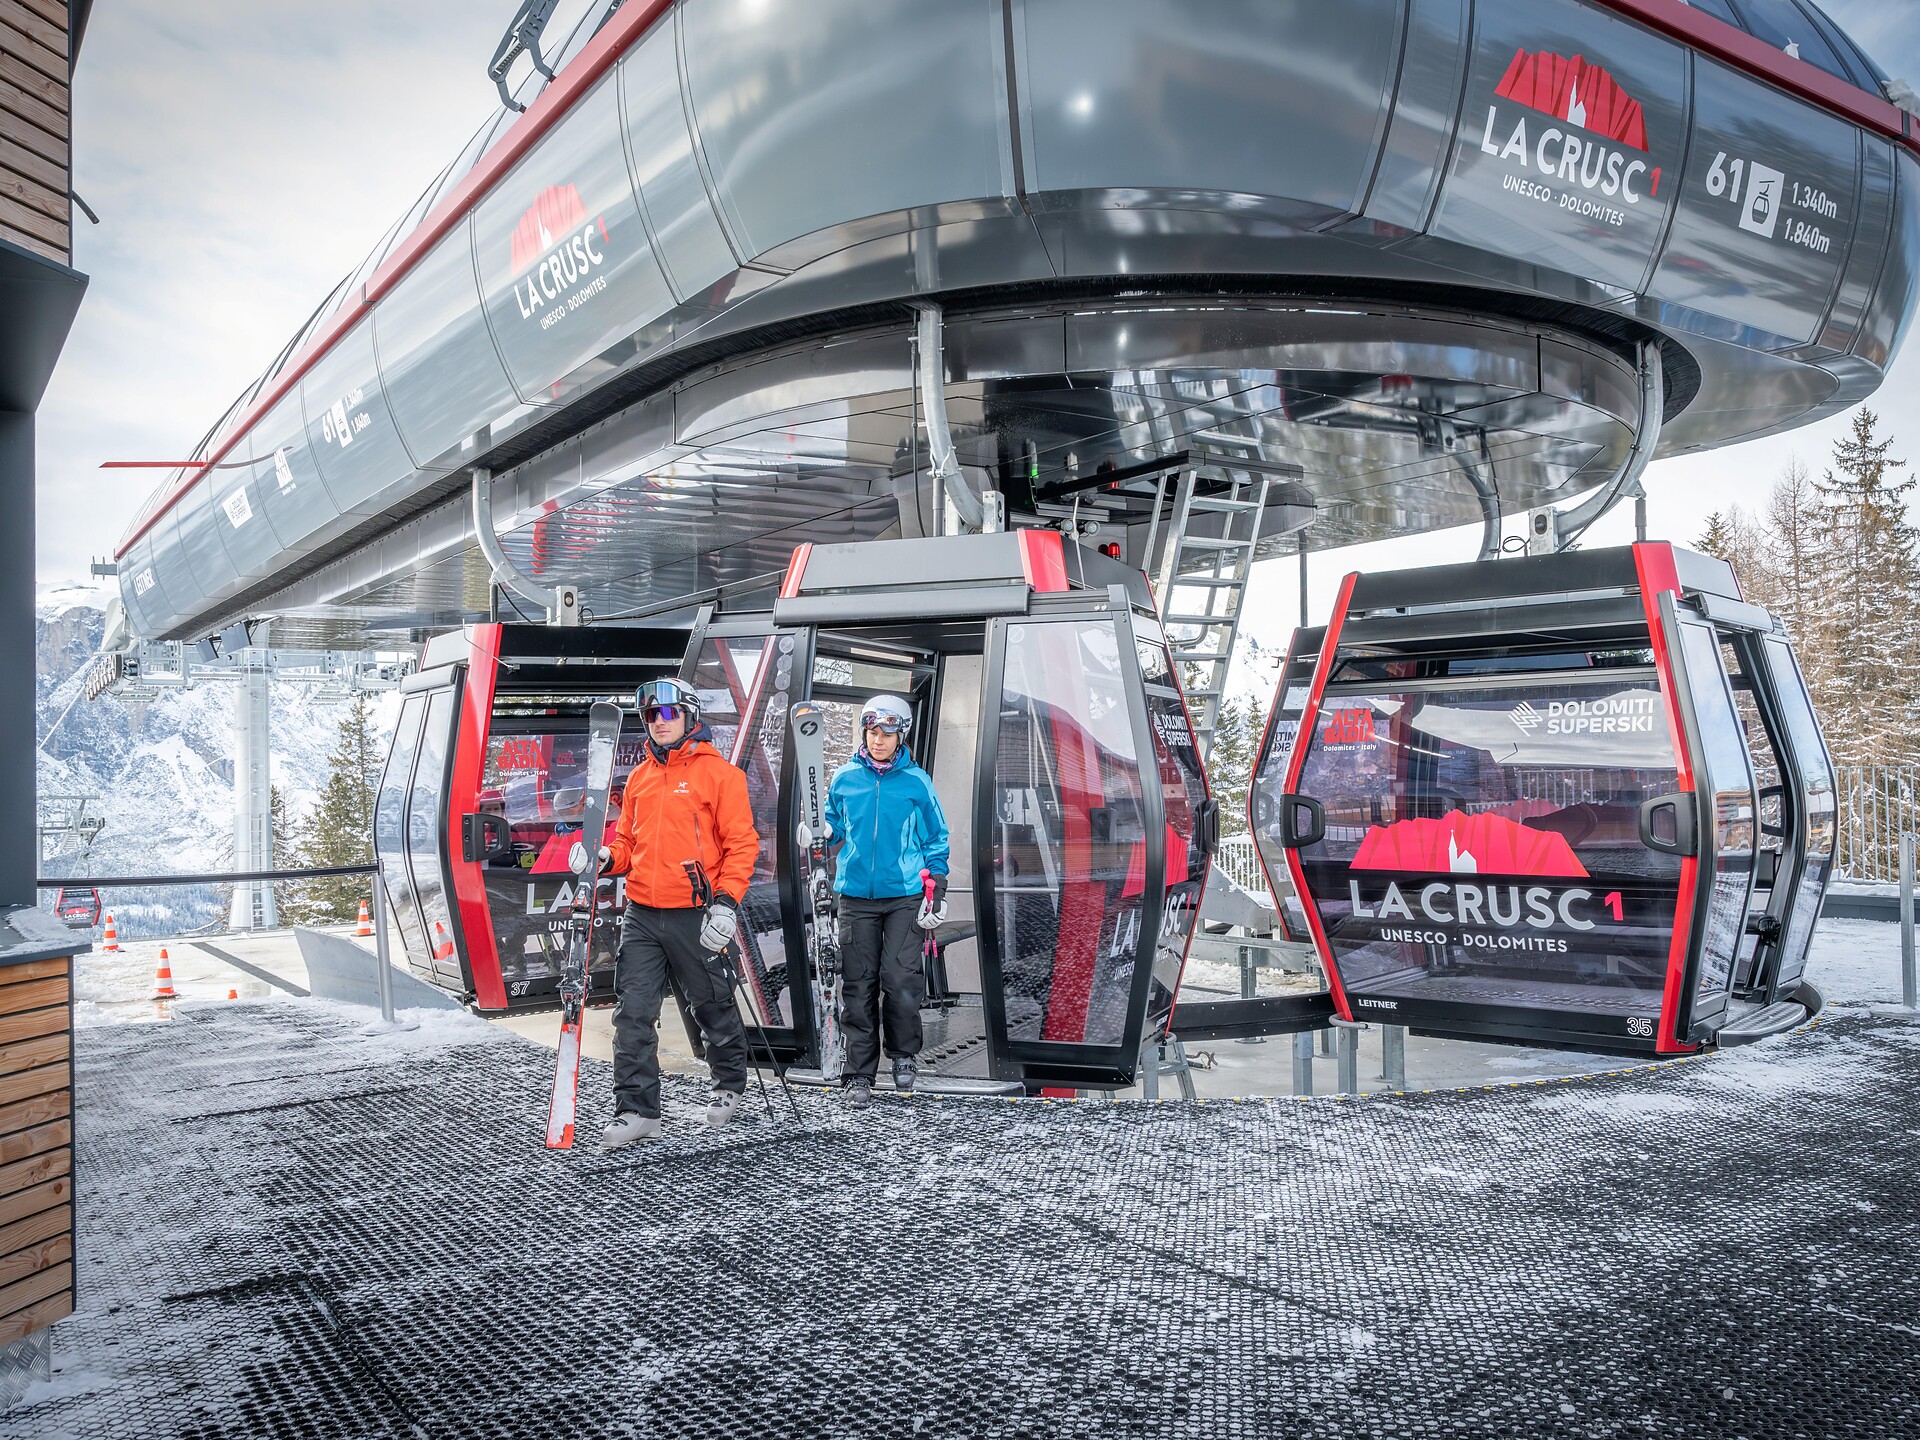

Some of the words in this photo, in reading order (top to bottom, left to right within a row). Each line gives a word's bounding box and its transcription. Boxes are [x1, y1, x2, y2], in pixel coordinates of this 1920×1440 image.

[1481, 105, 1527, 166] LA
[1537, 128, 1646, 203] CRUSC
[1650, 167, 1662, 196] 1
[1706, 151, 1744, 203] 61
[1503, 174, 1551, 202] UNESCO
[1559, 193, 1625, 226] DOLOMITES
[1792, 182, 1837, 218] 1.340m
[1785, 218, 1830, 253] 1.840m
[514, 275, 544, 319] LA
[539, 224, 603, 299] CRUSC
[597, 215, 609, 244] 1
[540, 306, 565, 330] UNESCO
[568, 275, 607, 311] DOLOMITES
[322, 411, 337, 443] 61
[1331, 708, 1373, 727] ALTA
[1549, 698, 1654, 717] DOLOMITI
[1324, 725, 1376, 744] BADIA
[1547, 715, 1653, 734] SUPERSKI
[502, 739, 542, 754] ALTA
[1323, 744, 1355, 752] Dolomites
[1361, 743, 1377, 751] Italy
[497, 755, 547, 769] BADIA
[534, 769, 549, 777] Italy
[808, 765, 820, 828] BLIZZARD
[526, 880, 574, 914] LA
[1349, 879, 1415, 921] LA
[1420, 882, 1596, 931] CRUSC
[1604, 891, 1624, 921] 1
[549, 917, 604, 931] UNEO
[1110, 908, 1135, 958] LA
[1381, 928, 1448, 945] UNESCO
[1463, 933, 1568, 953] DOLOMITES
[511, 981, 530, 996] 37
[1358, 998, 1398, 1010] LEITNER
[1626, 1016, 1653, 1036] 35
